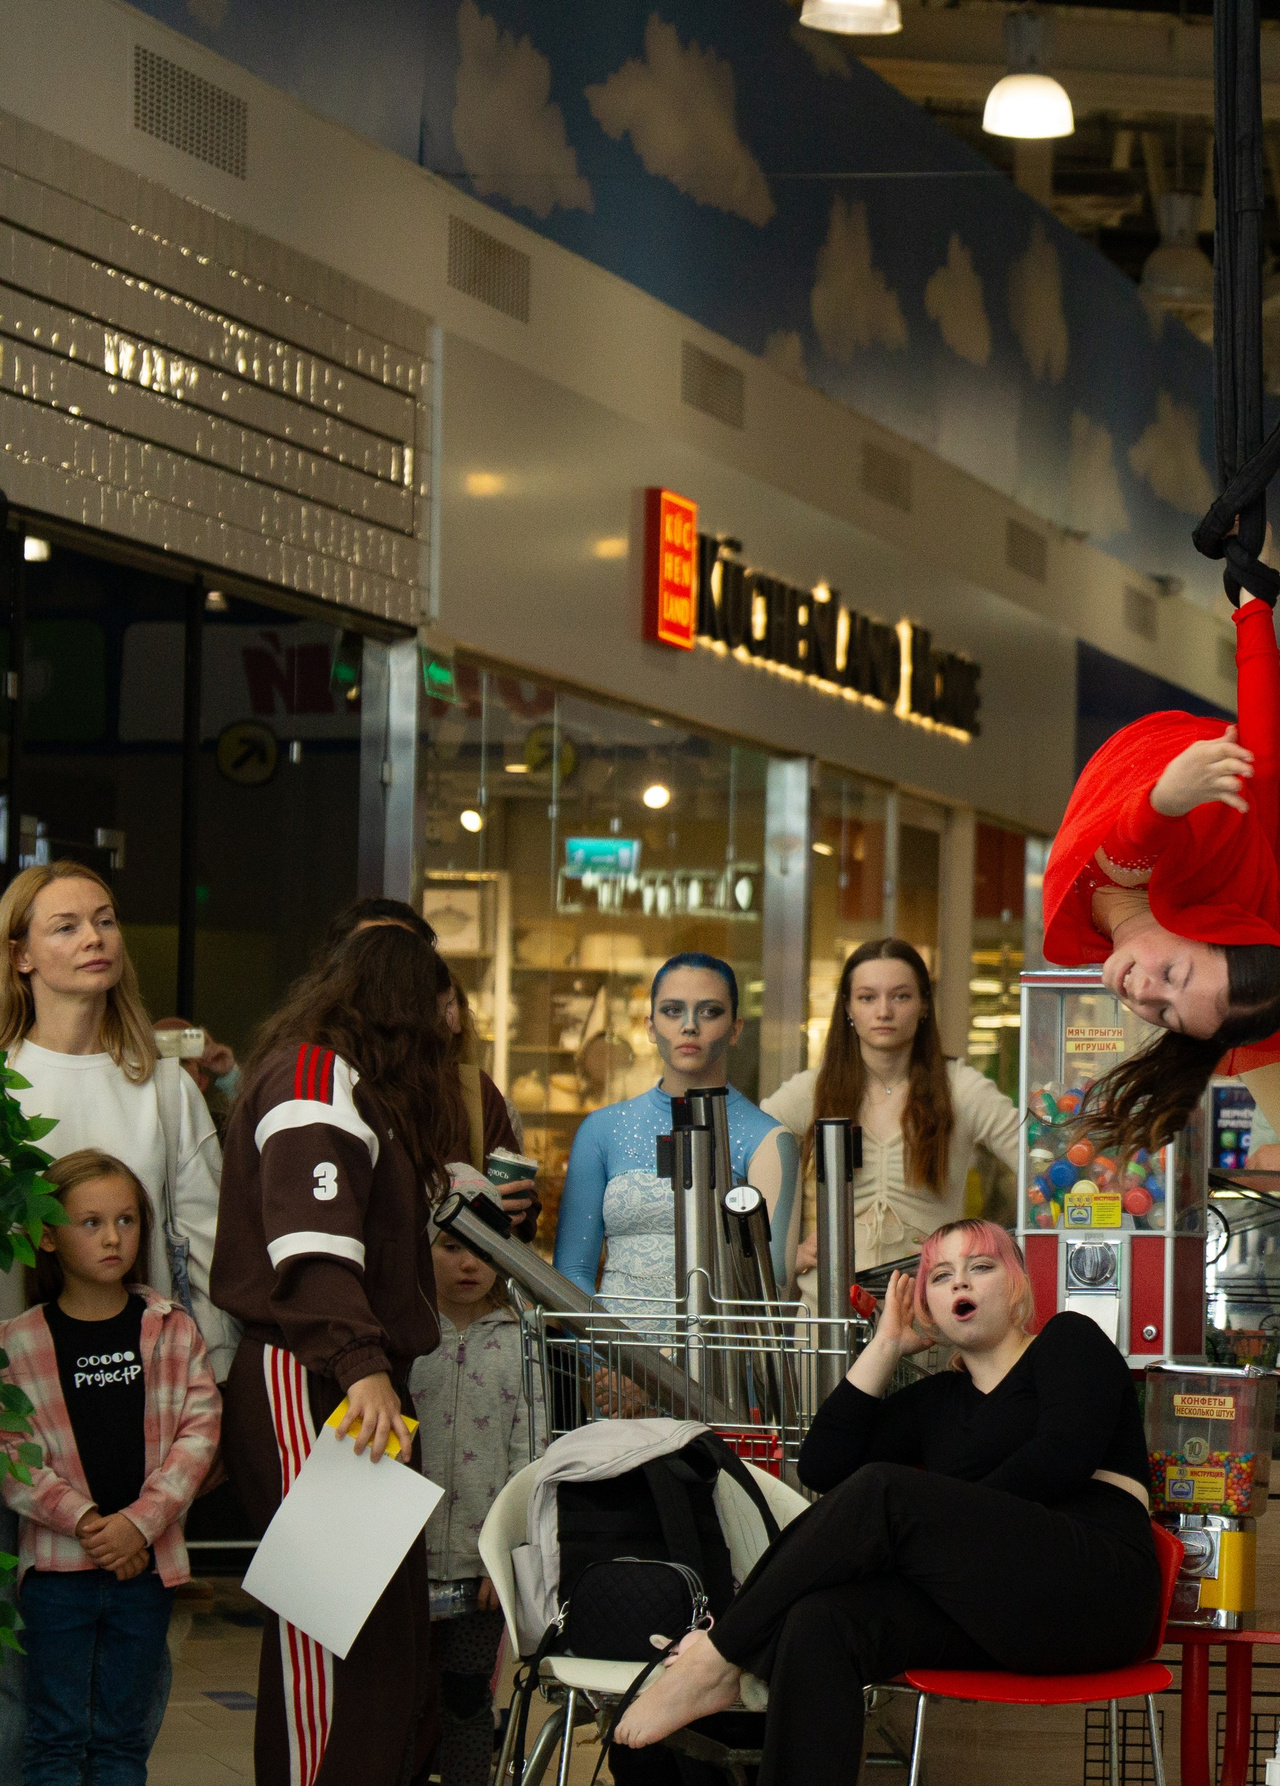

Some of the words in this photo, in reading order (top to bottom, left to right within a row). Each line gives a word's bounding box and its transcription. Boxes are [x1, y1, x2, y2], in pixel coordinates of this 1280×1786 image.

[1067, 1028, 1086, 1037] МЯЧ
[1088, 1028, 1123, 1037] ПРЫГУН
[1074, 1042, 1118, 1051] ИГРУШКА
[313, 1161, 338, 1201] 3
[1180, 1396, 1226, 1407] КОНФЕТЫ
[1176, 1407, 1215, 1417] НЕСКОЛЬКО
[1216, 1409, 1235, 1418] ШТУК
[1186, 1440, 1203, 1457] 10
